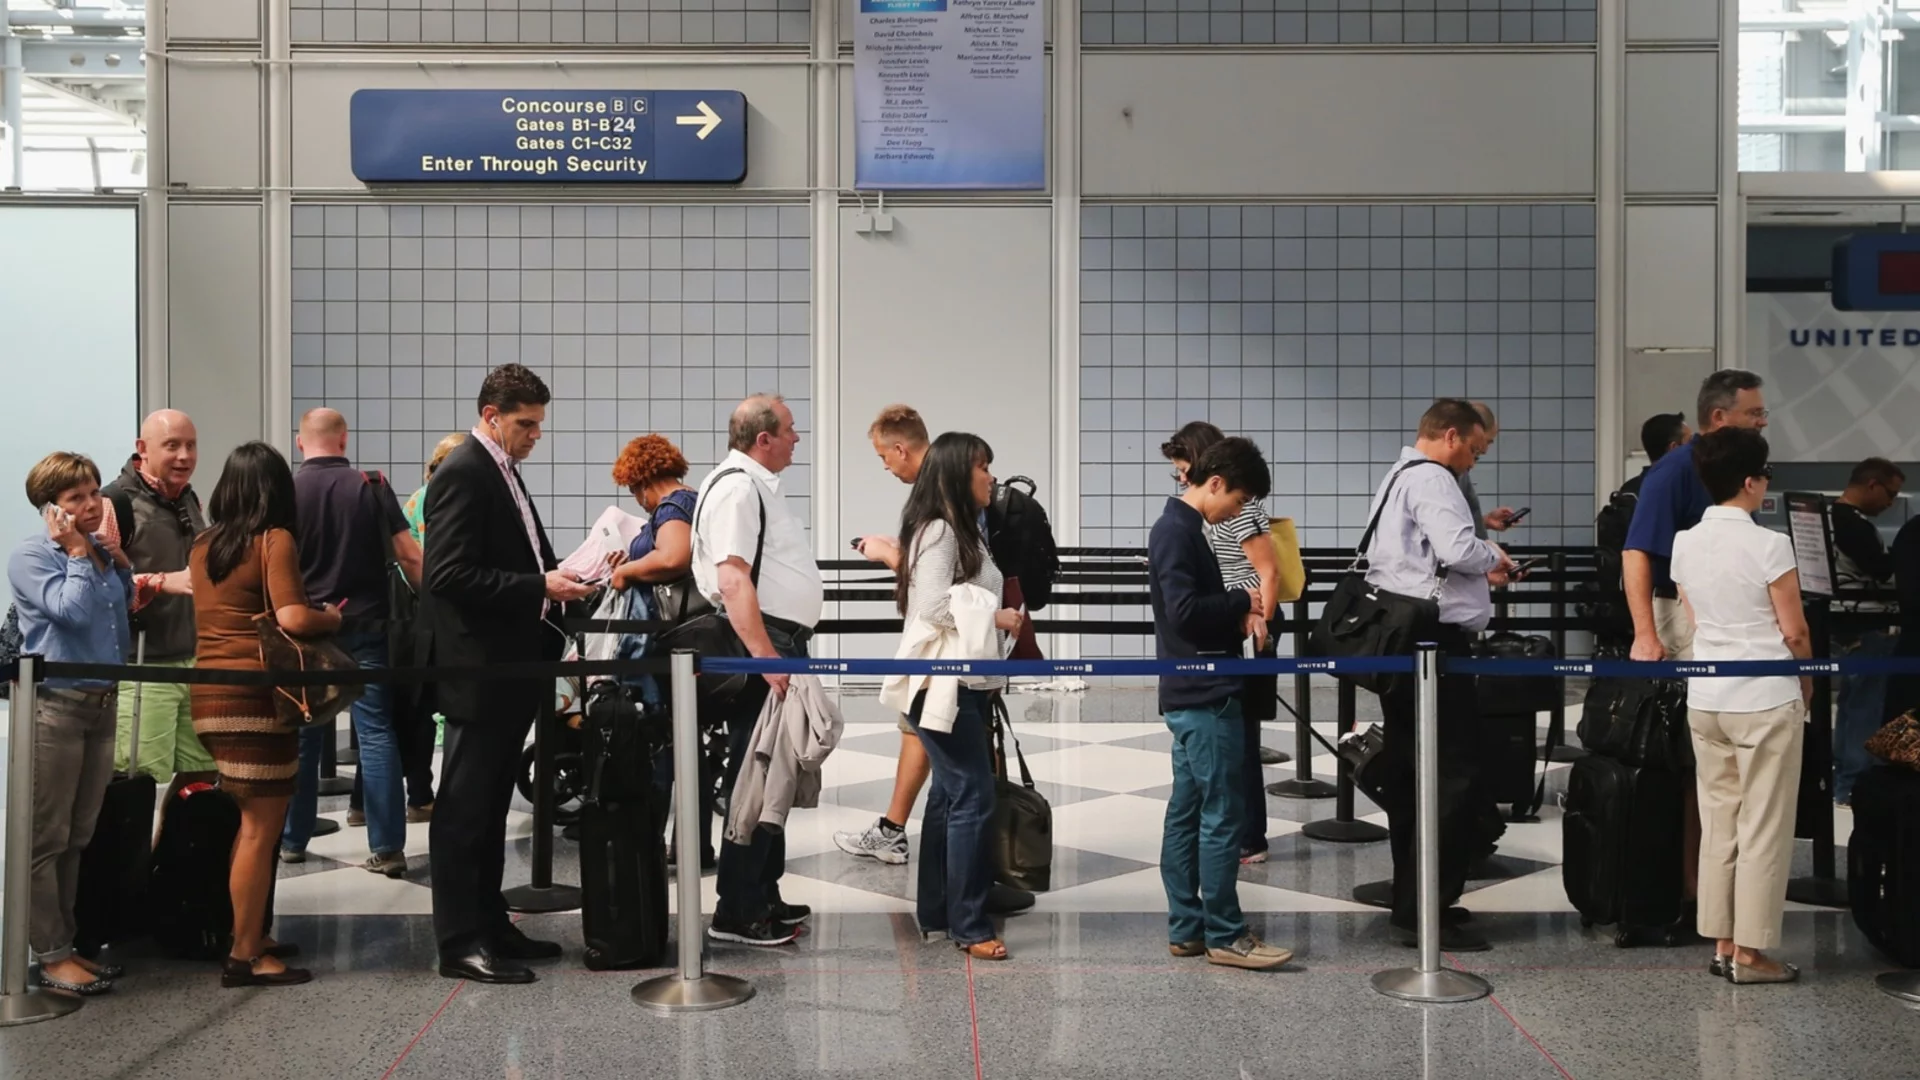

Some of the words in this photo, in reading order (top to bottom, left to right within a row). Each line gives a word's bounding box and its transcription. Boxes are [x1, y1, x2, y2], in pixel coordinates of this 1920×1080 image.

[502, 98, 606, 113] Concourse
[613, 99, 624, 112] B
[633, 99, 645, 112] C
[516, 118, 565, 132] Gates
[572, 117, 636, 133] B1-B24
[516, 136, 565, 150] Gates
[571, 136, 632, 150] C1-C32
[421, 156, 473, 171] Enter
[480, 156, 558, 174] Through
[566, 156, 647, 174] Security
[1790, 329, 1920, 347] UNITED
